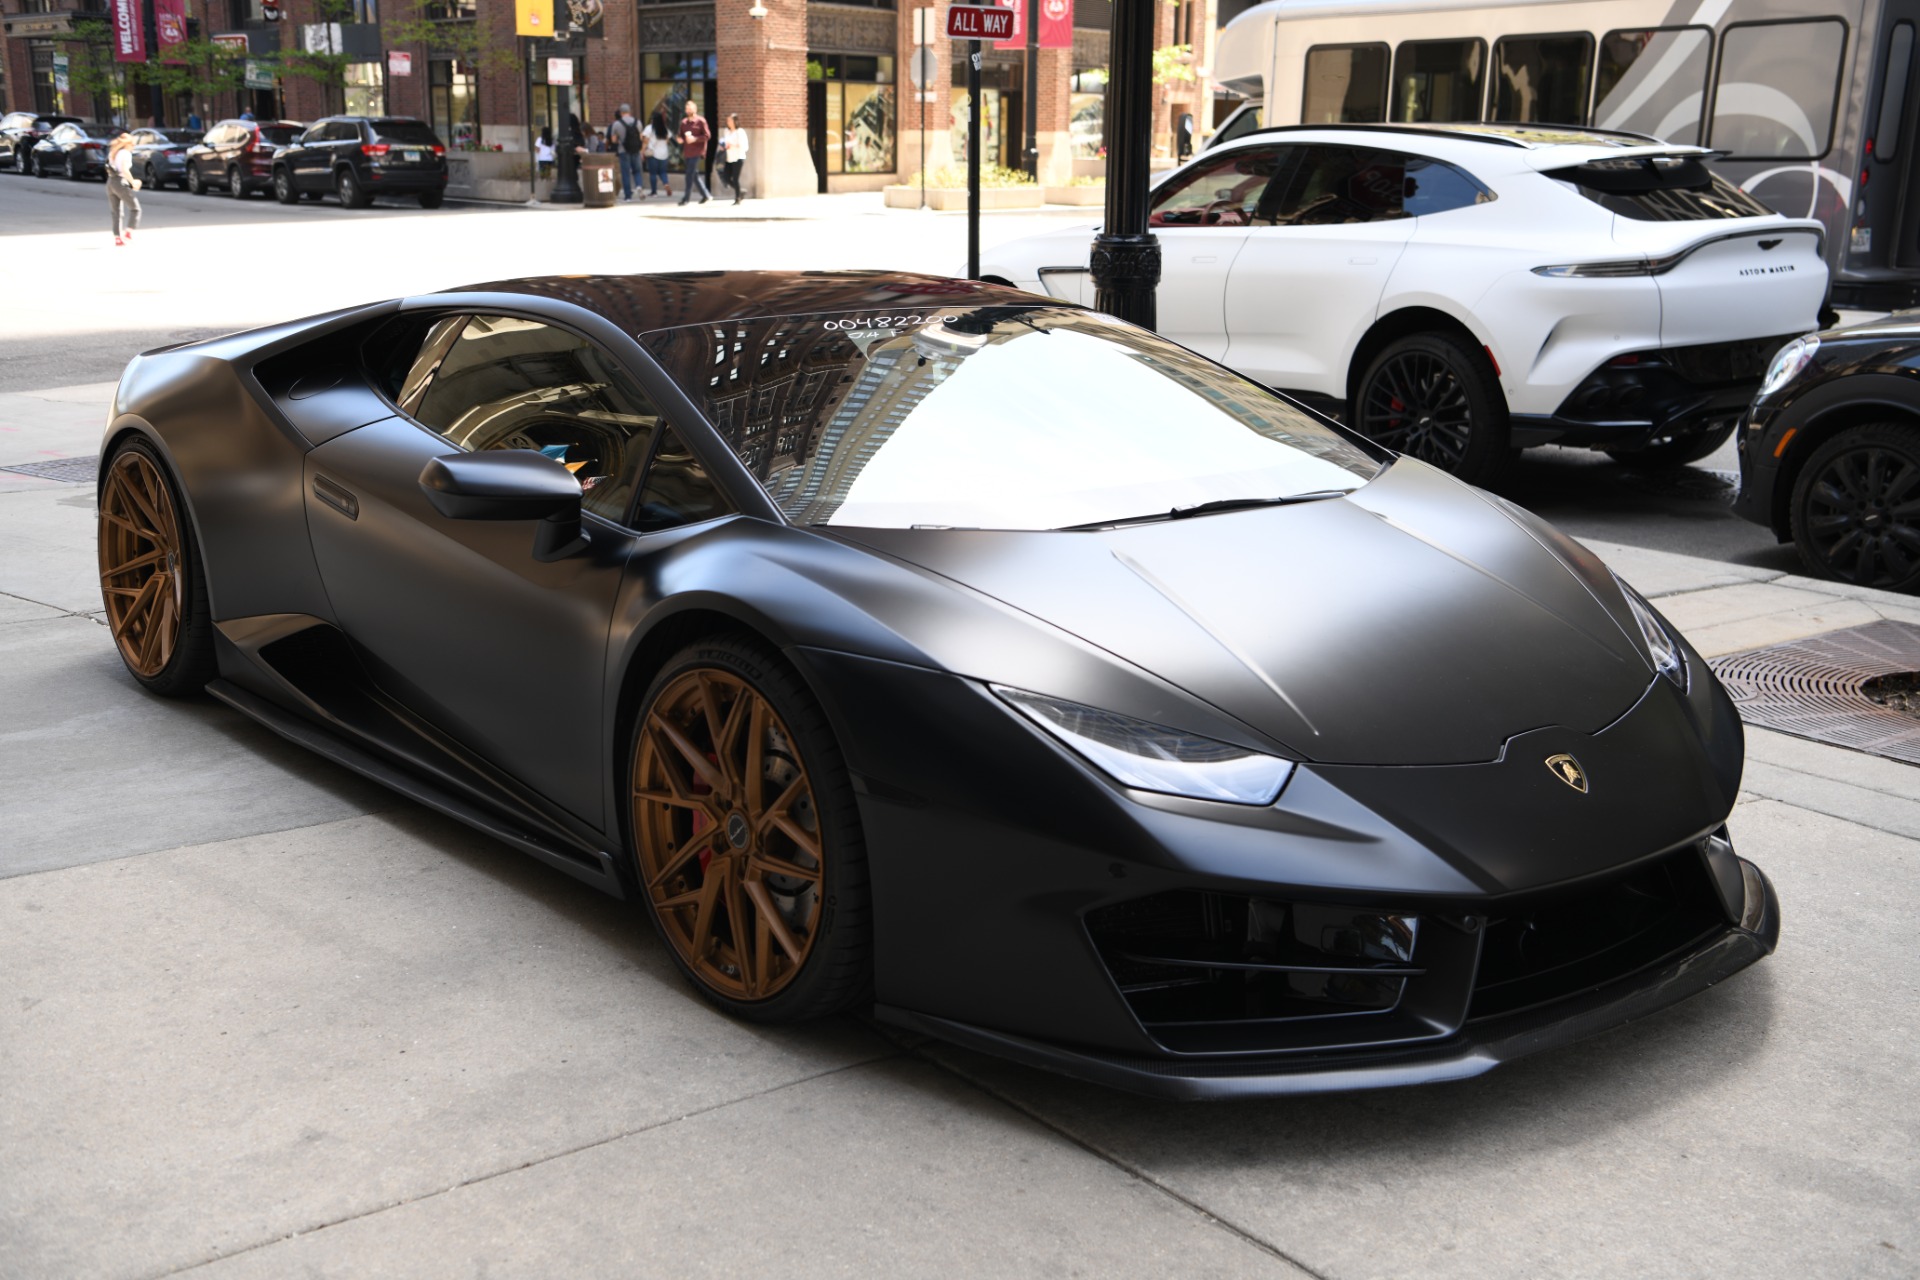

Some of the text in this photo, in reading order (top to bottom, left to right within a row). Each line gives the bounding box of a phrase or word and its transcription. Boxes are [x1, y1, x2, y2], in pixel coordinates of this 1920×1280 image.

[116, 0, 133, 54] WELCOM
[953, 12, 978, 32] ALL
[983, 13, 1008, 34] WAY
[1739, 265, 1795, 276] ASTON MARTIN
[823, 315, 959, 331] 00482200
